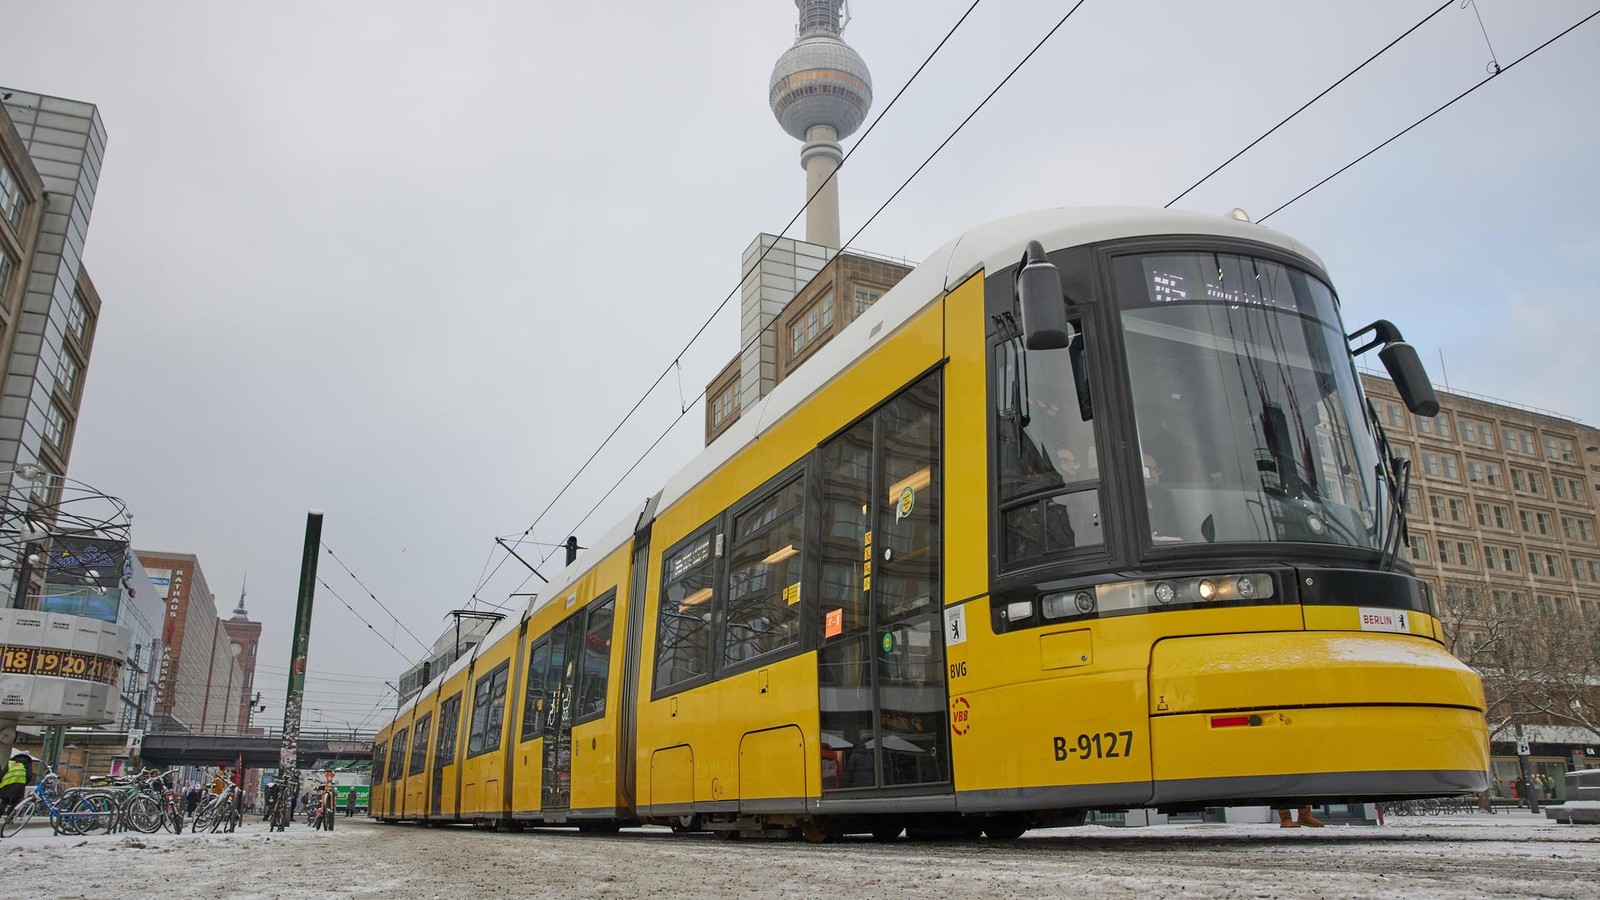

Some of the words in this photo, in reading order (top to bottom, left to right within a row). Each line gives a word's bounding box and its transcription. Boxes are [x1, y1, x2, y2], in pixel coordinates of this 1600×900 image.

[170, 570, 183, 618] RATHAUS
[1363, 614, 1392, 625] BERLIN
[5, 651, 28, 669] 18
[37, 654, 59, 671] 19
[61, 657, 85, 675] 20
[87, 660, 103, 678] 21
[156, 646, 171, 703] PASSAGEN
[950, 661, 967, 679] BVG
[953, 710, 969, 723] VBB
[1053, 731, 1133, 762] B-9127
